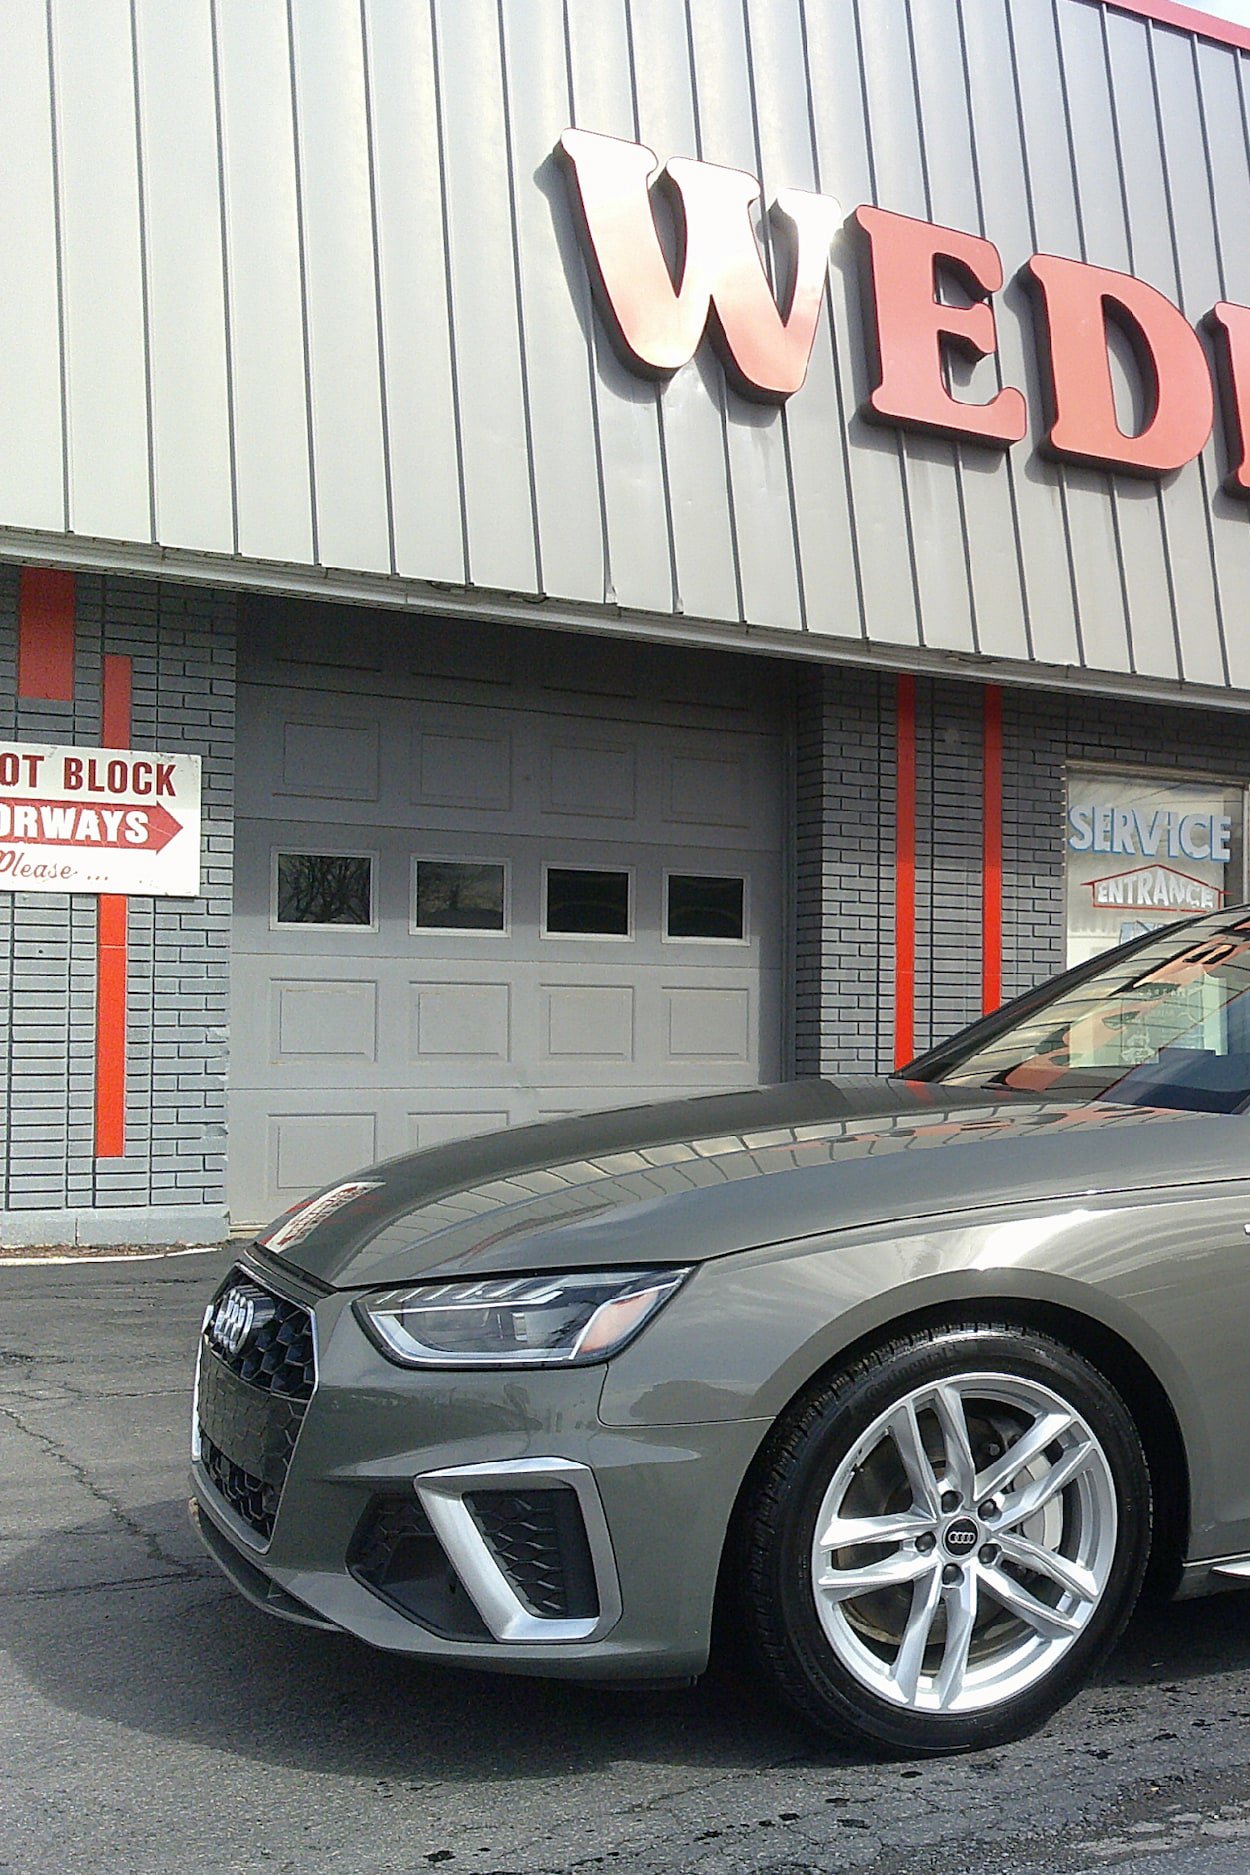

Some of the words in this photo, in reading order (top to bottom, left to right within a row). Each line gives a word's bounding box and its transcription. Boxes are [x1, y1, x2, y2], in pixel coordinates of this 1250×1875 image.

[64, 757, 177, 797] BLOCK
[1068, 803, 1231, 863] SERVICE
[1097, 870, 1214, 909] ENTRANCE
